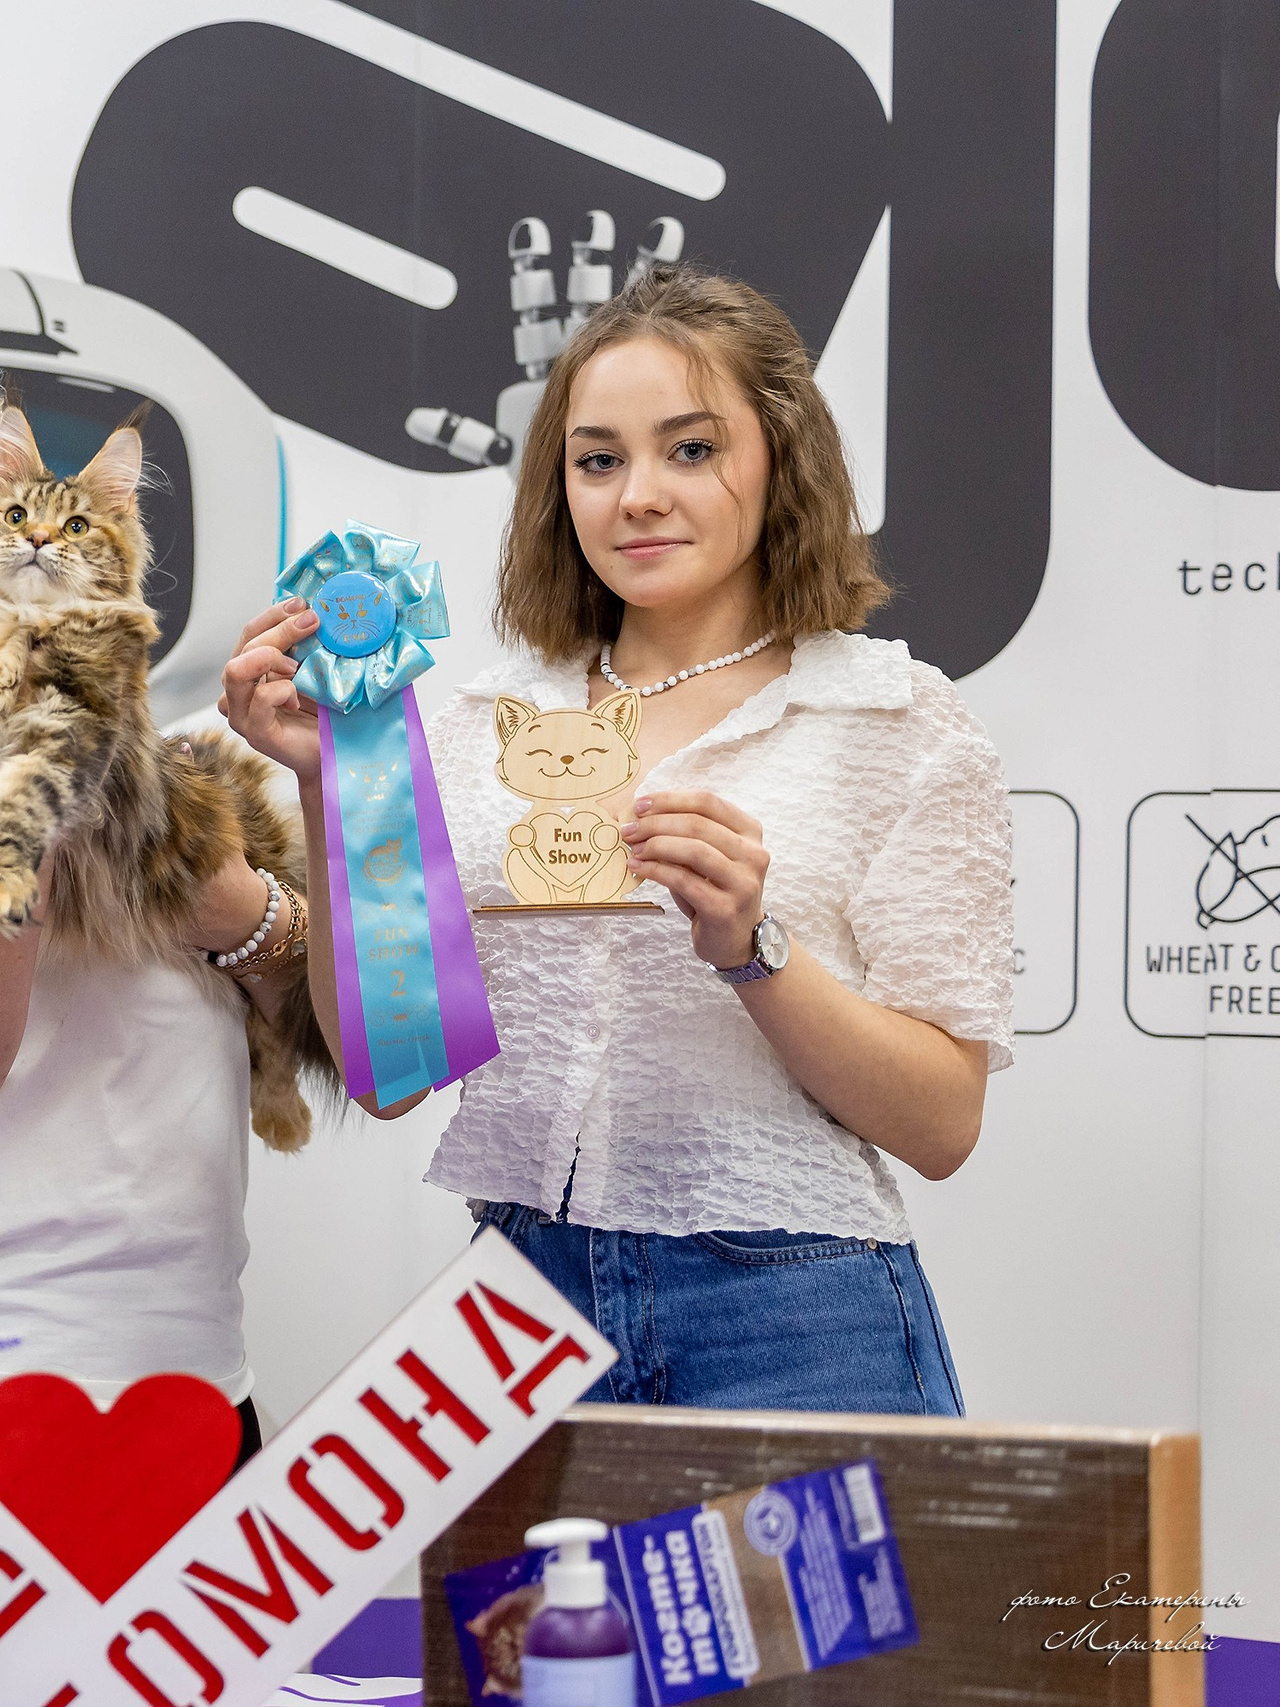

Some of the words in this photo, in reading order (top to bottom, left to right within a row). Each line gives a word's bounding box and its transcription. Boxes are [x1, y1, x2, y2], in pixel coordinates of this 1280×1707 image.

[1178, 553, 1280, 595] tec
[553, 828, 582, 843] Fun
[548, 849, 592, 865] Show
[1146, 944, 1233, 974] WHEAT
[390, 968, 407, 998] 2
[1209, 985, 1280, 1014] FREE
[38, 1280, 591, 1707] ОМОНД
